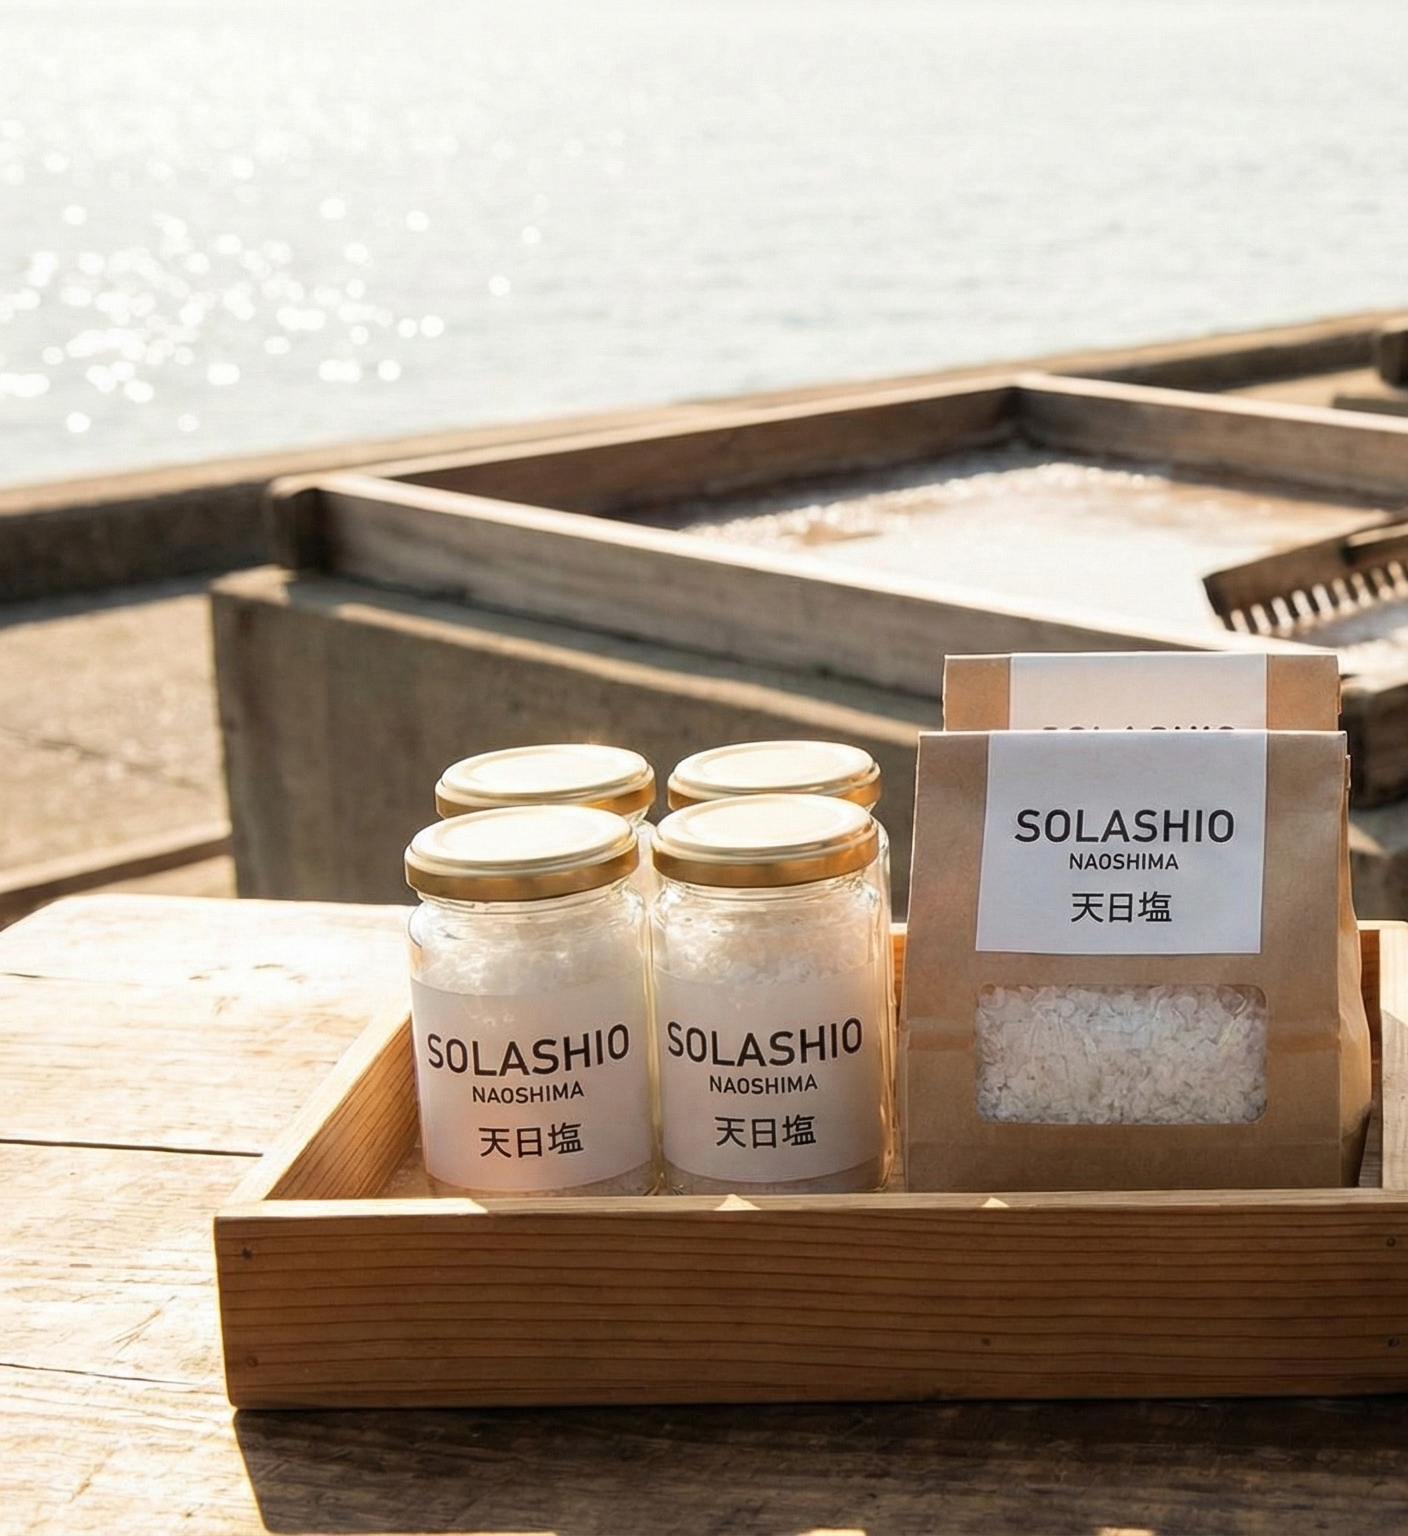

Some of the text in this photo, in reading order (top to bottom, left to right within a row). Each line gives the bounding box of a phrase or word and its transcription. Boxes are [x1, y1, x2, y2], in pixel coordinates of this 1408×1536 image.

[1014, 809, 1234, 843] SOLASHIO
[1069, 852, 1179, 871] NAOSHIMA
[1070, 890, 1173, 923] 天日塩
[427, 1023, 630, 1077] SOLASHIO
[667, 1017, 863, 1067] SOLASHIO
[472, 1080, 585, 1104] NAOSHIMA
[709, 1073, 818, 1095] NAOSHIMA
[478, 1121, 584, 1159] 天日塩
[714, 1113, 817, 1149] 天日塩
